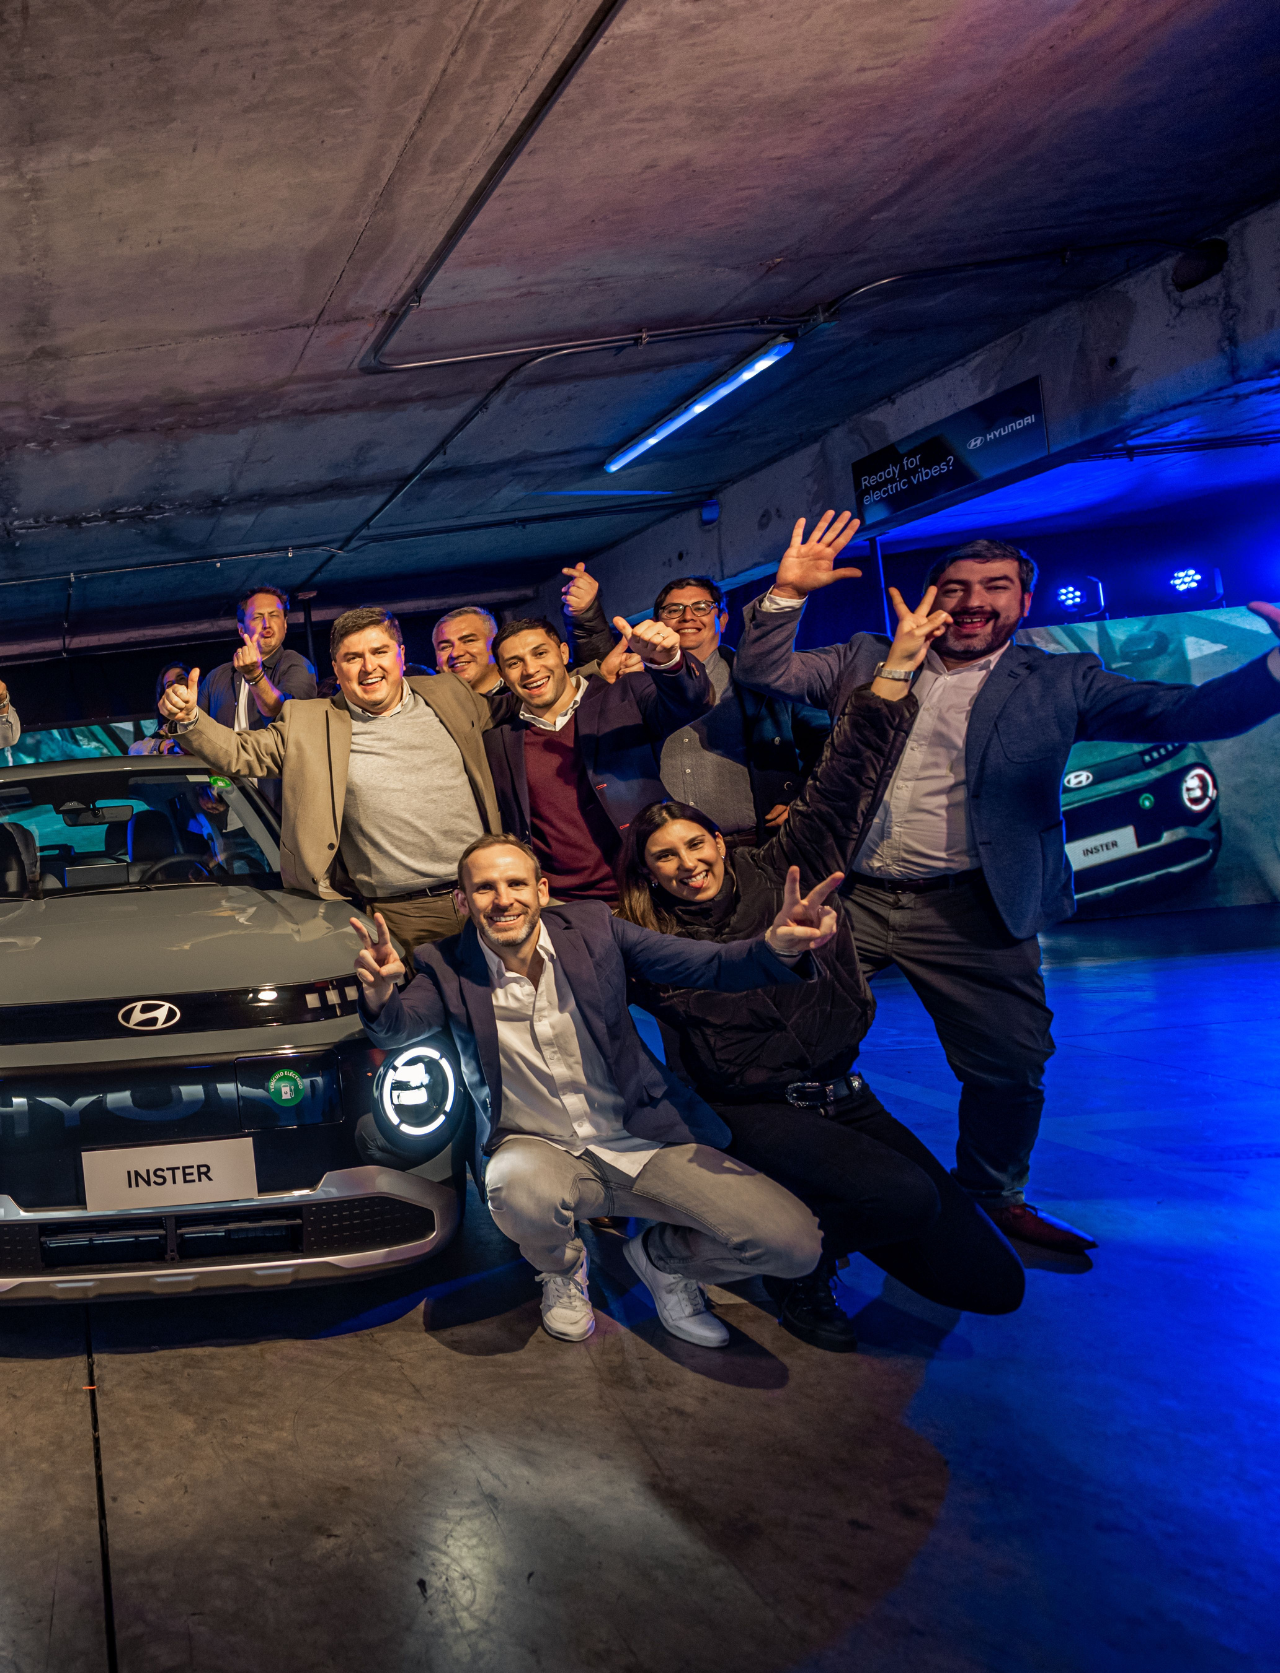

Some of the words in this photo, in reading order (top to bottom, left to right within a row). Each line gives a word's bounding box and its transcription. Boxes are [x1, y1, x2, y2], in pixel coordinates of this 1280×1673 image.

[986, 414, 1035, 441] HYUNDAI
[861, 463, 900, 489] Ready
[903, 454, 921, 470] for
[863, 478, 908, 505] electric
[910, 456, 954, 484] vibes?
[1082, 840, 1118, 857] INSTER
[126, 1163, 213, 1188] INSTER
